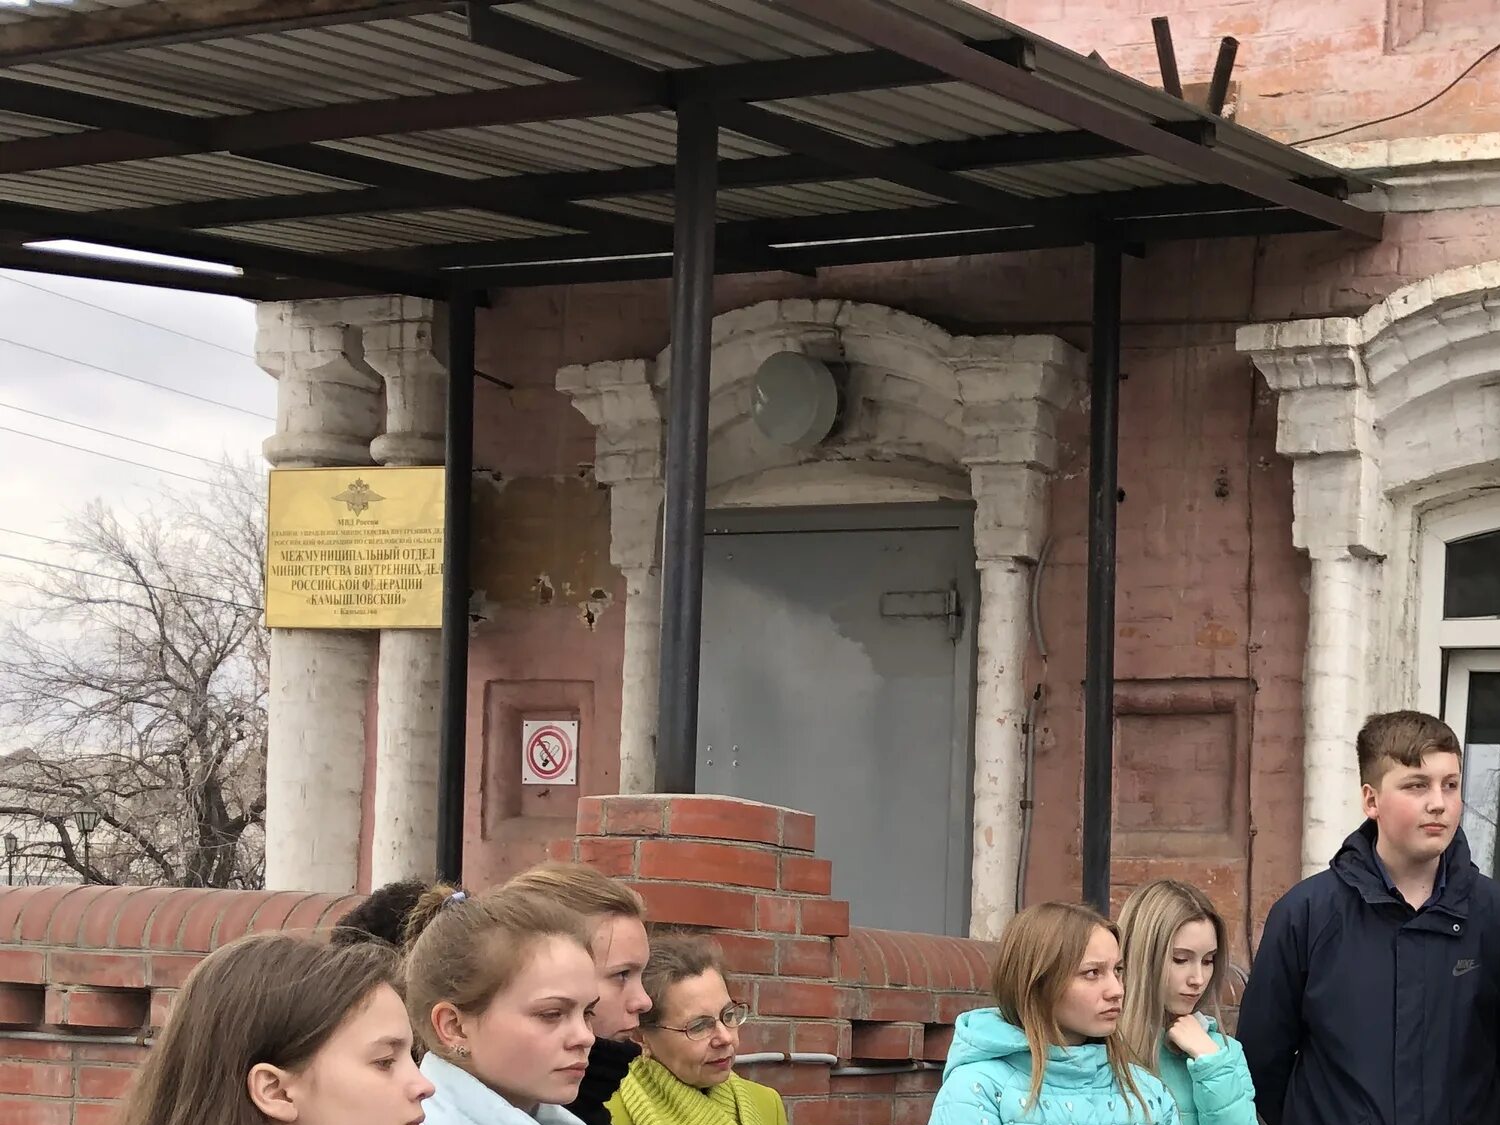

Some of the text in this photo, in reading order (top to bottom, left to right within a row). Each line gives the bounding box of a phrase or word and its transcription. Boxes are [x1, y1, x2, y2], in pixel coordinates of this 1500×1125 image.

[281, 546, 435, 562] МЕЖМУНИЦИПАЛЬНЫЙ ОТДЕЛ
[271, 562, 444, 577] МИНИСТЕРСТВА ВНУТРЕННИХ ДЕЛ
[291, 576, 423, 591] РОССИЙСКОЙ ФЕДЕРАЦИИ
[306, 590, 406, 606] «КАМЫШЛОВСКИЙ»
